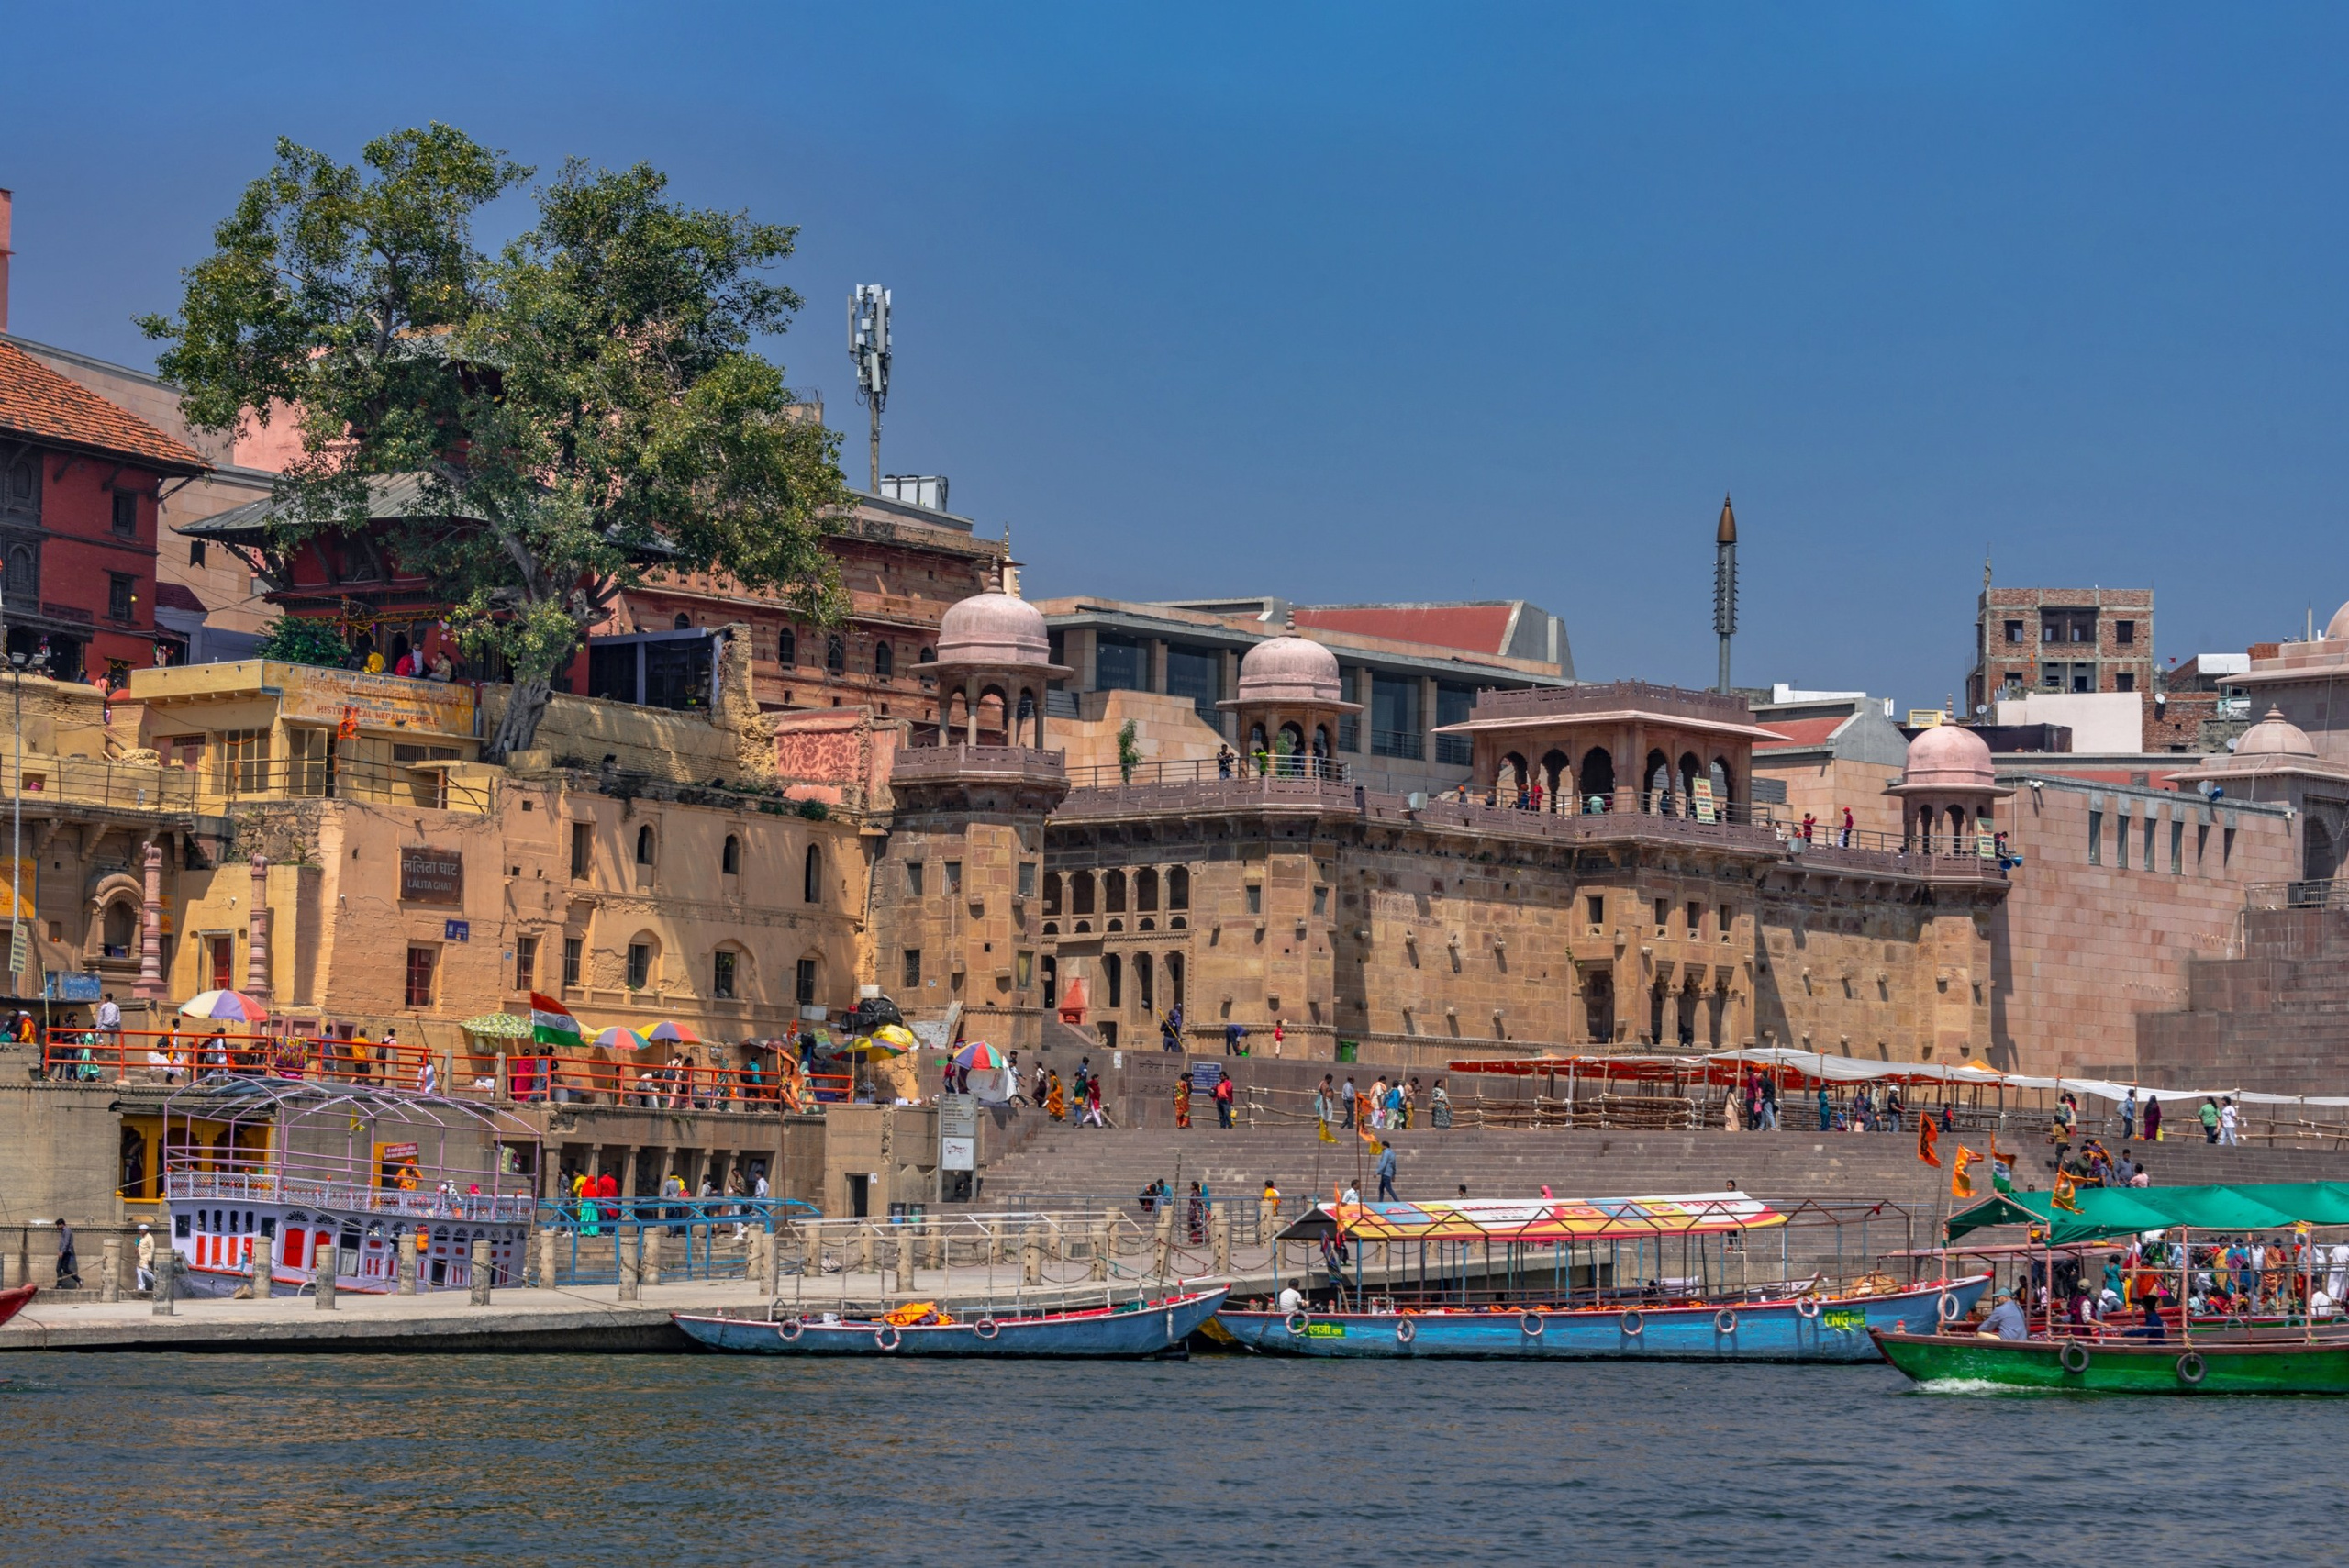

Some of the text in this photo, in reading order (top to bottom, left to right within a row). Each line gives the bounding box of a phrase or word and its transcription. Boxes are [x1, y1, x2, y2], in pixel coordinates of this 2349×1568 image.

[375, 711, 403, 722] NEPALI
[405, 714, 440, 725] TEMPLE
[403, 855, 458, 876] ललिता घाट
[407, 879, 452, 891] LALITA GHAT
[1824, 1311, 1849, 1327] CNG
